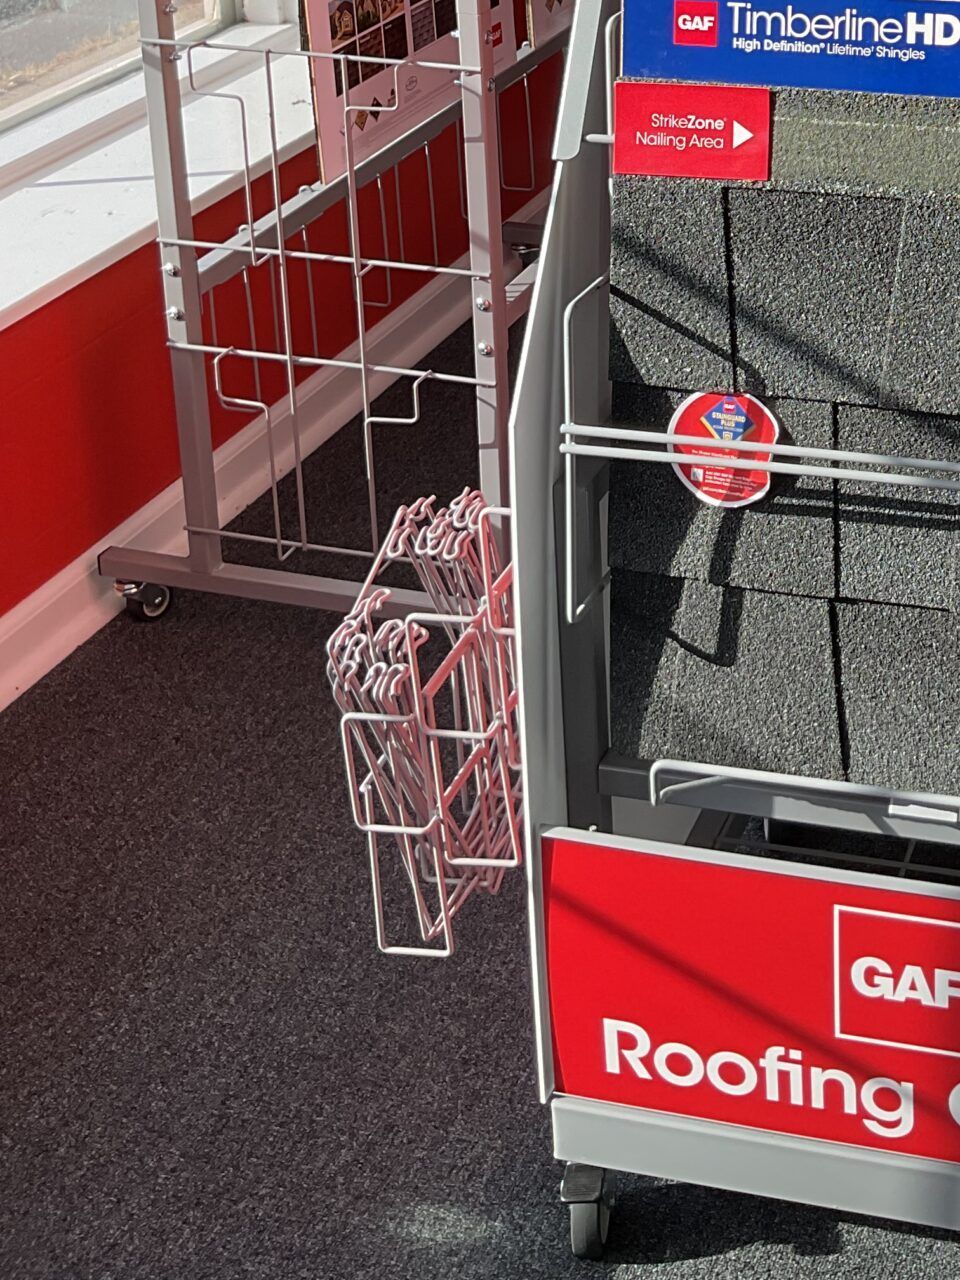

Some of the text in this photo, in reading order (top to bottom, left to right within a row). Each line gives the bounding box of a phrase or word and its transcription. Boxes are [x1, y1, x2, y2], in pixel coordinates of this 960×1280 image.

[677, 14, 715, 31] GAF
[732, 37, 761, 52] High
[876, 47, 926, 62] Shingles
[635, 131, 724, 150] Nailing Area
[602, 1018, 914, 1138] Roofing
